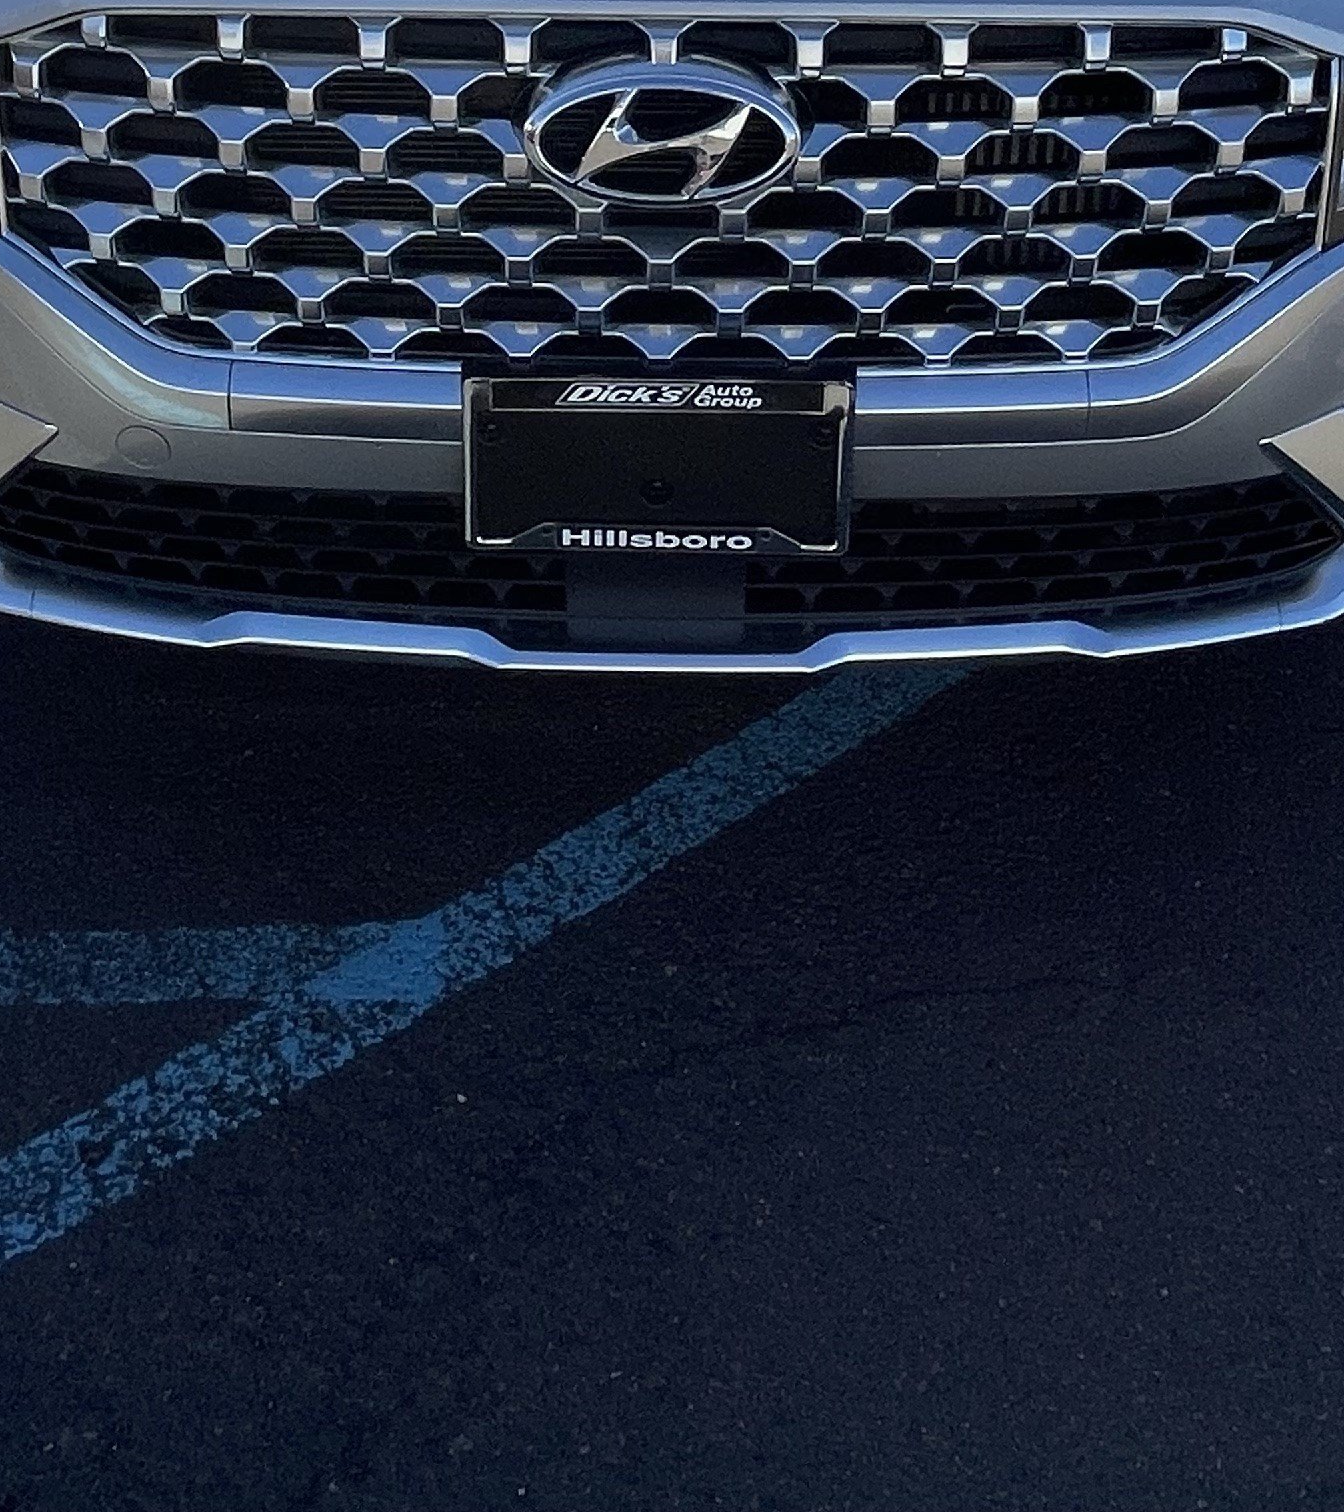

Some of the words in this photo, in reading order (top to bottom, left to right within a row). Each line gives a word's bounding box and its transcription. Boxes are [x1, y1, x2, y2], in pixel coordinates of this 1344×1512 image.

[567, 384, 683, 403] Dick's
[702, 384, 754, 397] Auto
[693, 396, 762, 410] Group
[562, 528, 753, 550] Hillsboro
